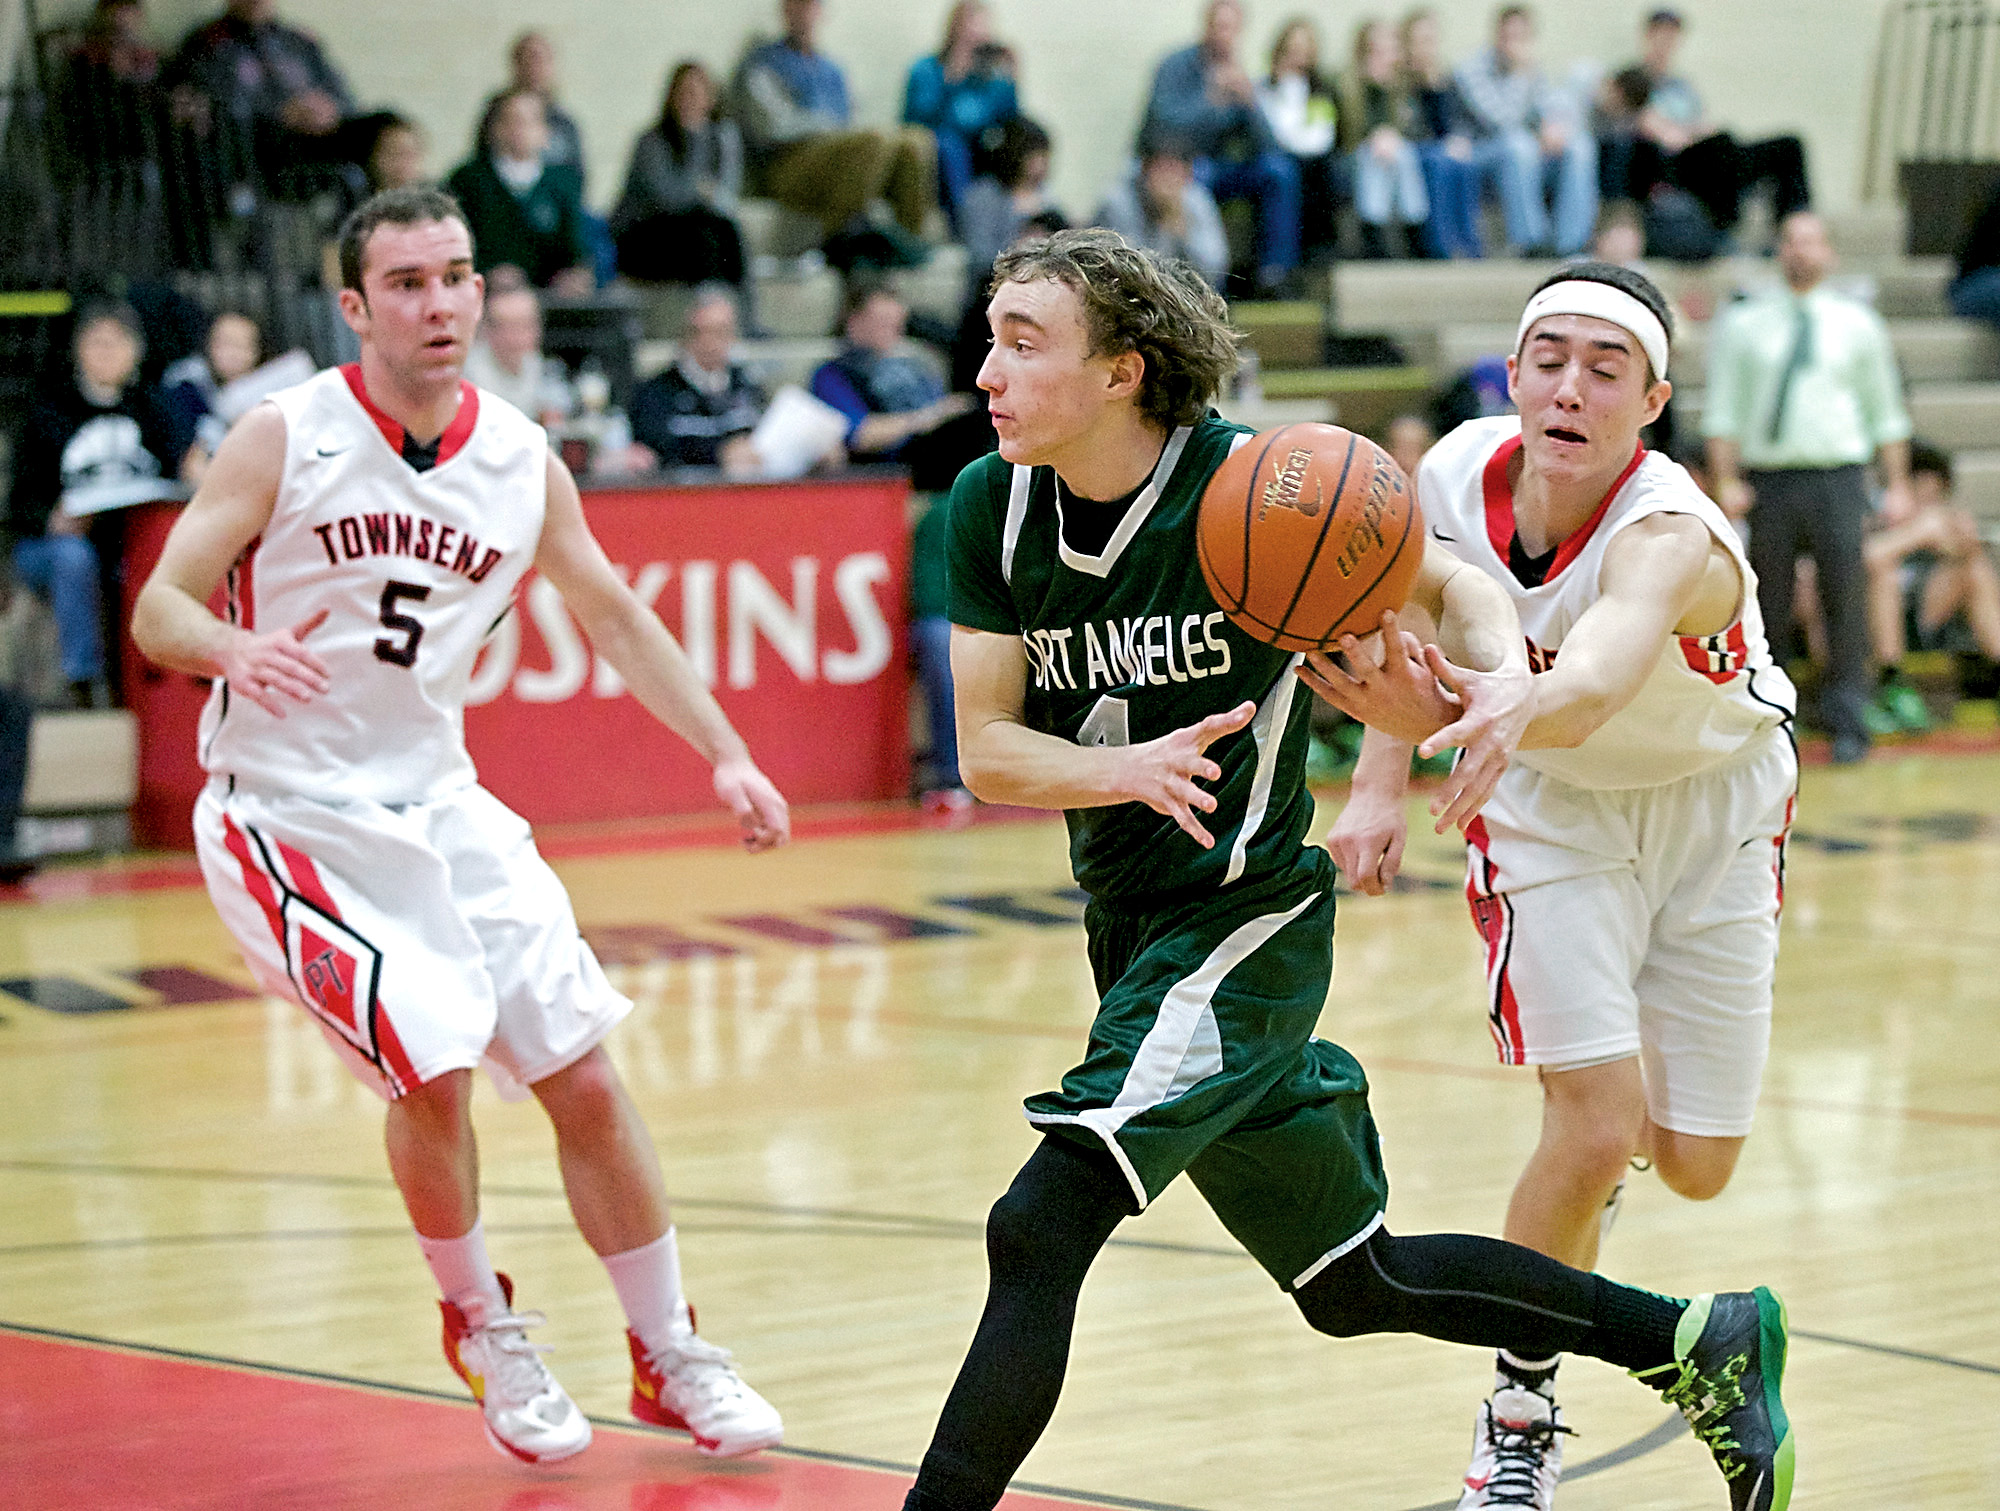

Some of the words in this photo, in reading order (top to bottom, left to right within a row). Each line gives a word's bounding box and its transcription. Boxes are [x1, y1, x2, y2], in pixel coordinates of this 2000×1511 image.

[313, 513, 503, 583] TOWNSEND
[373, 579, 431, 669] 5
[1020, 624, 1078, 691] ORT
[1084, 611, 1232, 691] ANGELES
[304, 948, 347, 1007] PT
